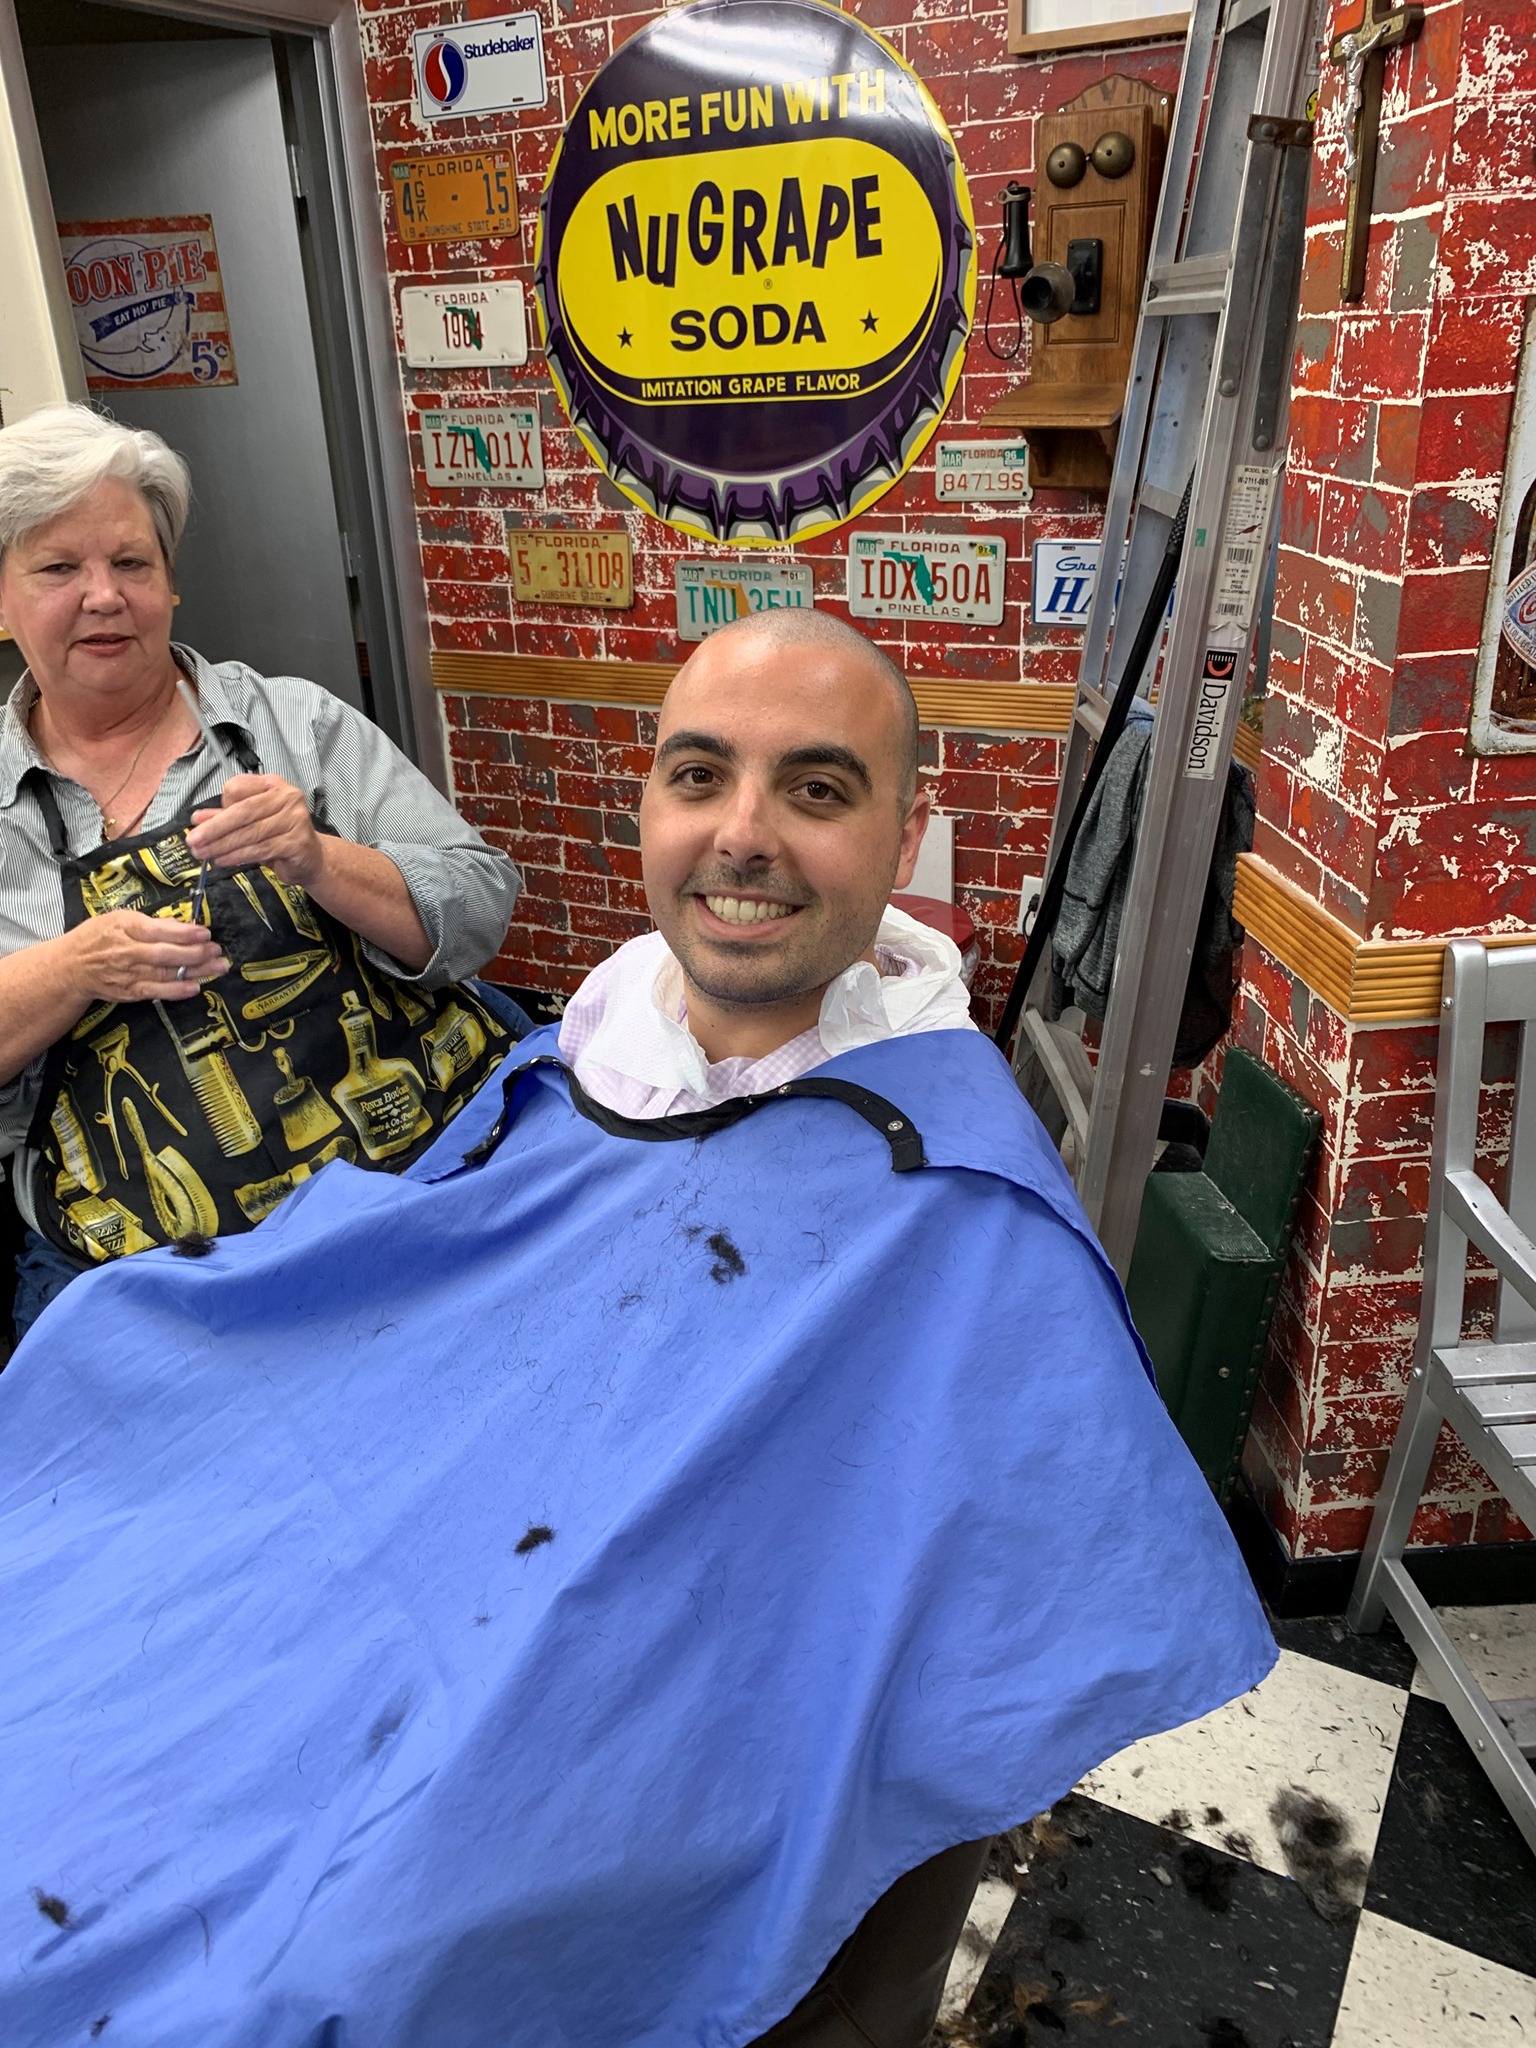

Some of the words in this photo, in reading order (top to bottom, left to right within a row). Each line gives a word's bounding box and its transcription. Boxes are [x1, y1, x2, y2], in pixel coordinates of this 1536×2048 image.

[463, 35, 535, 59] Studebaker
[589, 97, 691, 150] MORE
[701, 85, 774, 135] FUN
[782, 68, 885, 125] WITH
[418, 158, 484, 178] FLORIDA
[402, 182, 415, 223] 4
[483, 171, 509, 215] 15
[467, 220, 490, 232] STATE
[66, 255, 134, 304] OON
[141, 243, 205, 290] PIE
[434, 292, 489, 306] FLORIDA
[114, 313, 131, 326] EAT
[152, 297, 167, 311] PIE
[443, 311, 484, 348] 1964
[670, 301, 827, 352] SODA
[641, 379, 722, 398] IMITATION
[728, 377, 786, 394] GRAPE
[796, 373, 860, 391] FLAVOR
[451, 414, 504, 425] FLORIDA
[942, 453, 962, 467] MAR
[962, 449, 1004, 459] FLORIDA
[1004, 451, 1017, 460] 96
[456, 472, 512, 481] PINELLAS
[943, 472, 1024, 491] 84719S
[514, 536, 527, 546] 75
[535, 536, 601, 548] FLORIDA
[857, 541, 876, 555] MAR
[891, 541, 960, 554] FLORIDA
[517, 550, 531, 586] 5
[557, 551, 623, 589] 31108
[682, 569, 699, 582] MAR
[711, 568, 772, 581] FLORIDA
[888, 603, 961, 617] PINELLAS
[1187, 683, 1227, 770] Davidson
